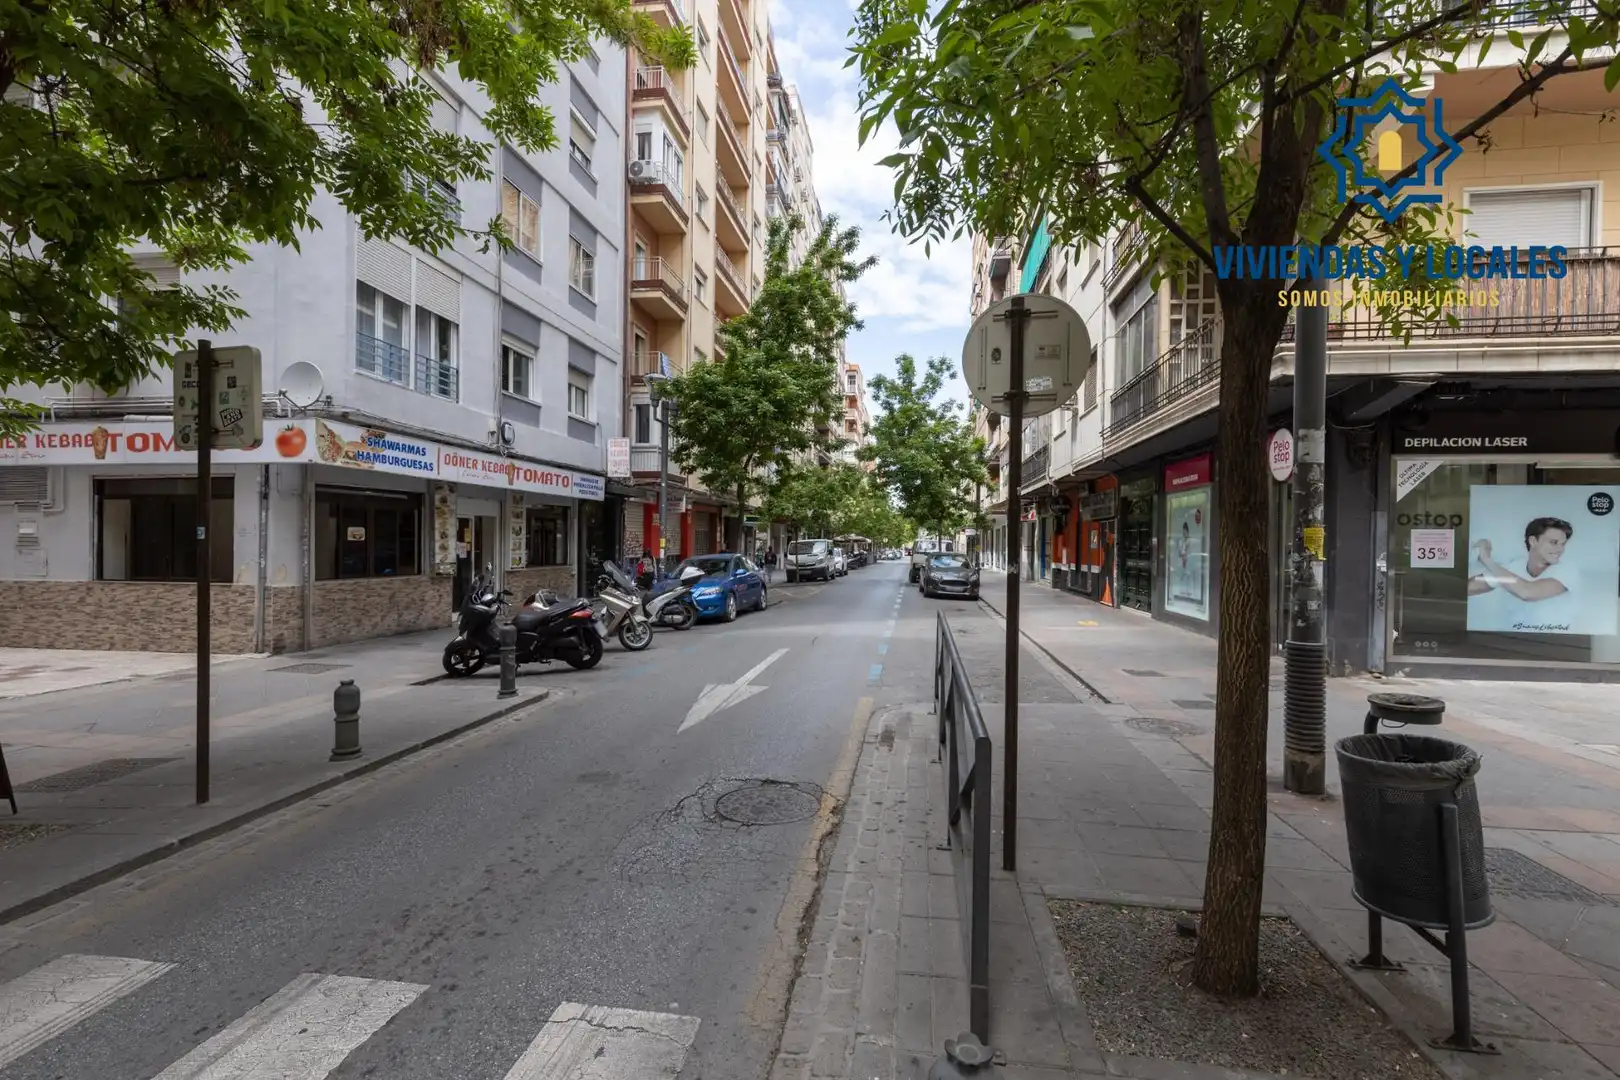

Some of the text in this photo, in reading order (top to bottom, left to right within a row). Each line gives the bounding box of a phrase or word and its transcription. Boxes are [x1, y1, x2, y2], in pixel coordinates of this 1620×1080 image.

[0, 433, 27, 448] ER
[35, 433, 94, 448] KEBAB
[367, 437, 427, 456] SHAWARMAS
[1273, 440, 1290, 452] Pelo
[356, 450, 434, 471] HAMBURGUESAS
[1273, 451, 1290, 463] stop
[444, 452, 478, 470] DÖNER
[513, 466, 570, 488] TOMATO
